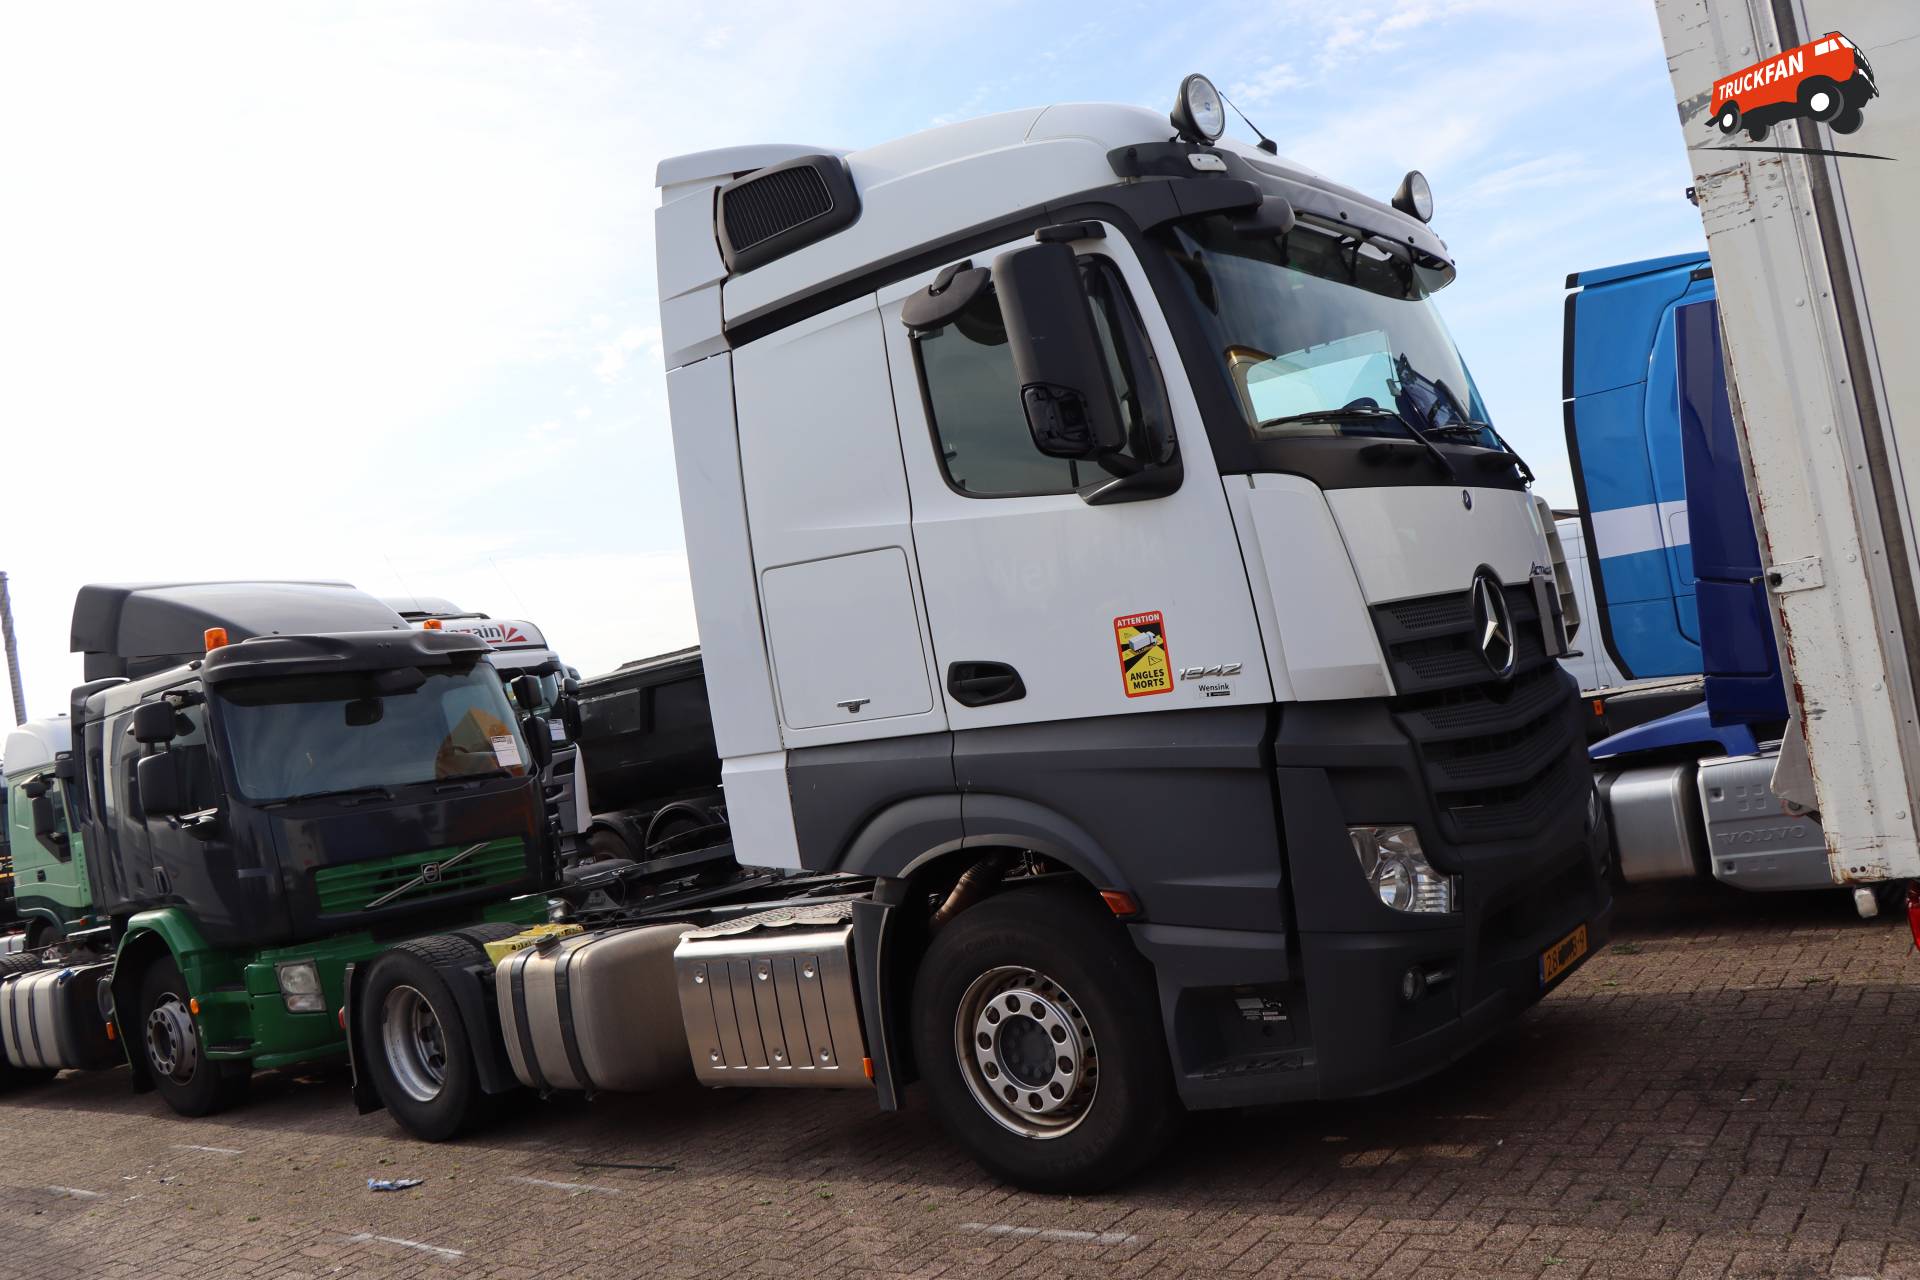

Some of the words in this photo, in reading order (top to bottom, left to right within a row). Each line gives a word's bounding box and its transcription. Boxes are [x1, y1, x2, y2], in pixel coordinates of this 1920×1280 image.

[1117, 613, 1160, 628] ATTENTION
[1130, 668, 1165, 682] ANGLES
[1179, 662, 1243, 682] 1942
[1133, 677, 1165, 690] MORTS
[1198, 682, 1230, 692] Wensink
[1716, 824, 1807, 845] VOLVO
